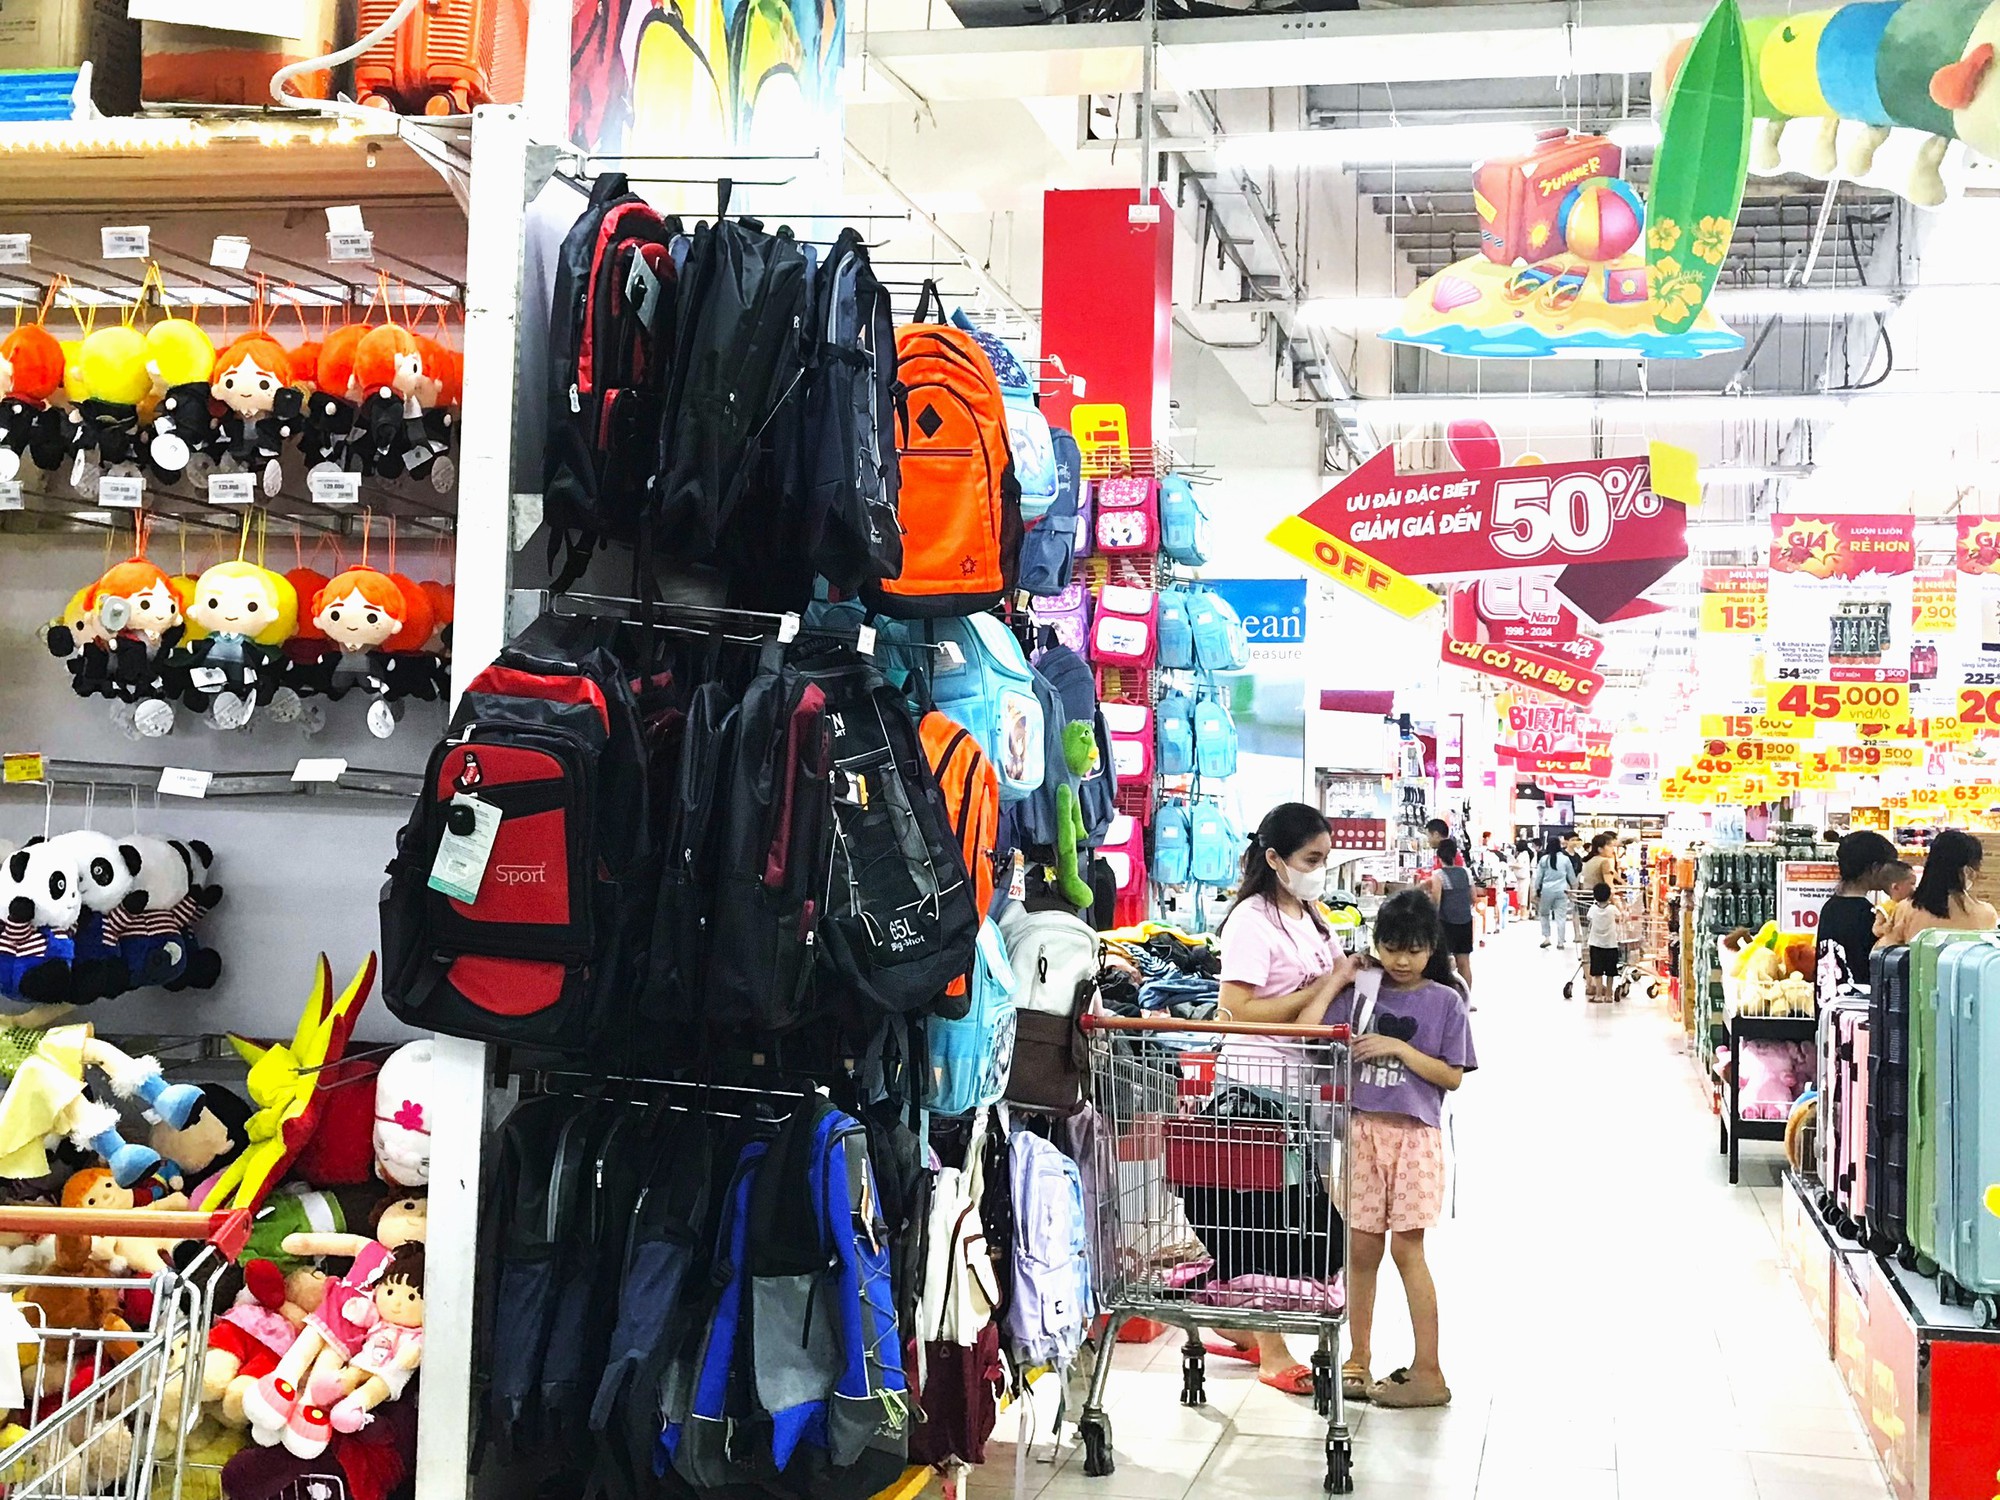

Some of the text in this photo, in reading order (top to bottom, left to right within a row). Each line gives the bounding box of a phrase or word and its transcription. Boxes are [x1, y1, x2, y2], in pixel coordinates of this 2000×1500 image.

[1538, 156, 1600, 197] SUMMER
[1346, 478, 1481, 512] ƯU ĐÃI ĐẶC BIỆT
[1350, 504, 1483, 542] GIẢM GIÁ ĐẾN
[1489, 464, 1664, 559] 50%
[1788, 530, 1829, 551] GIÁ
[1850, 536, 1910, 552] RẺ HƠN
[1313, 540, 1392, 591] OFF
[1242, 615, 1302, 638] ean
[1505, 626, 1553, 637] 1998 2024
[1248, 648, 1302, 660] leasure
[1482, 649, 1512, 668] CÓ
[1513, 657, 1540, 680] TẠI
[1543, 668, 1576, 692] Big
[1577, 679, 1593, 695] C
[1508, 705, 1578, 735] BIRTH
[1517, 731, 1565, 753] DAY
[496, 864, 546, 886] Sport
[890, 917, 917, 941] 65L
